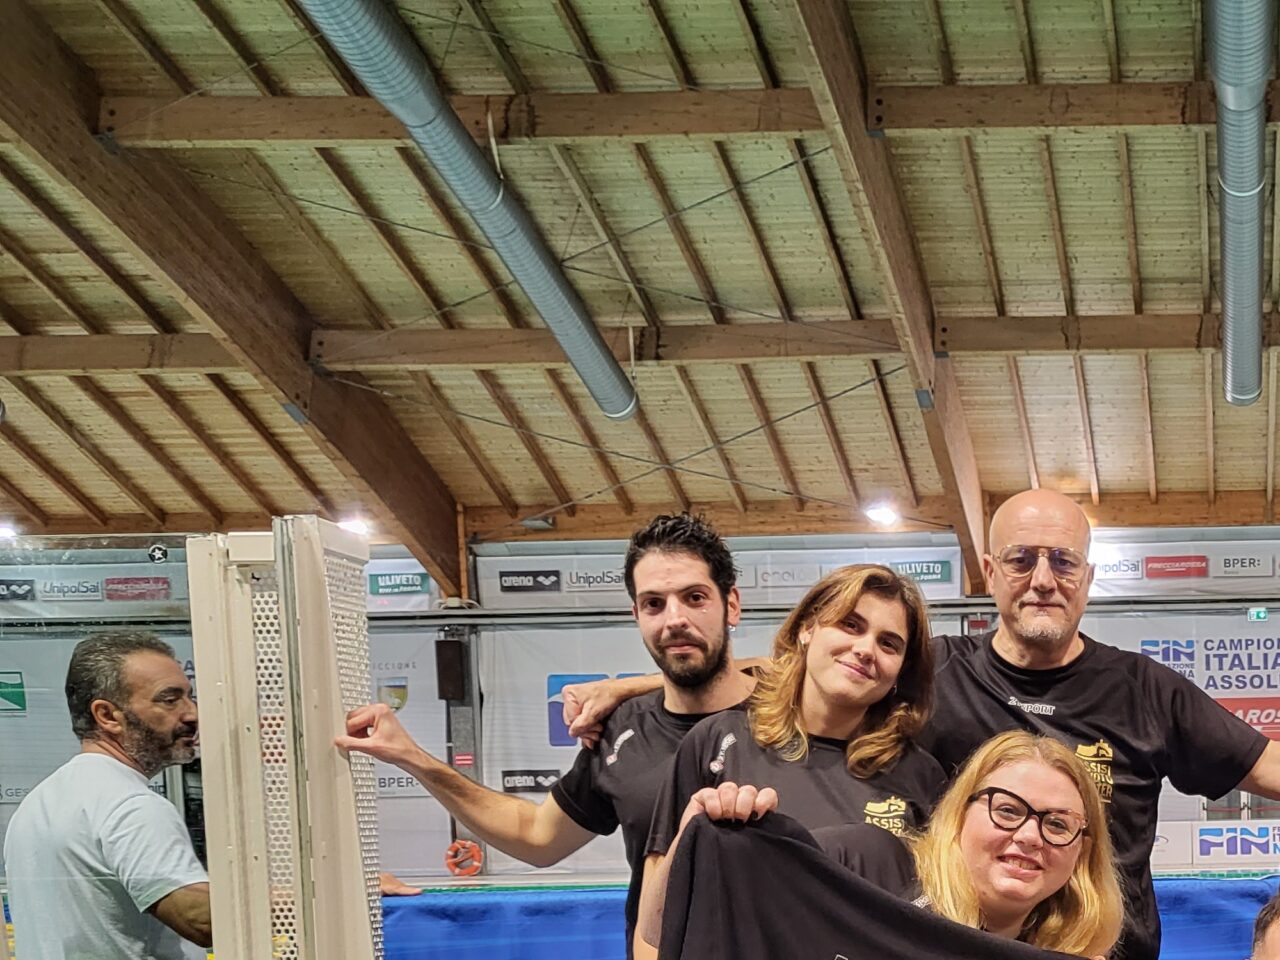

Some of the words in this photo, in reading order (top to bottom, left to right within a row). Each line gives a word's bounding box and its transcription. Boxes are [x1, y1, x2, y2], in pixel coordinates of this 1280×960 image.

[899, 563, 942, 574] ULIVETO
[1097, 559, 1140, 574] ipolSai
[1223, 557, 1261, 568] BPER:
[501, 575, 533, 586] arena
[569, 570, 624, 589] UnipolSai
[373, 661, 417, 670] ICCIONE
[1084, 761, 1111, 776] SSISI
[503, 774, 535, 787] arena
